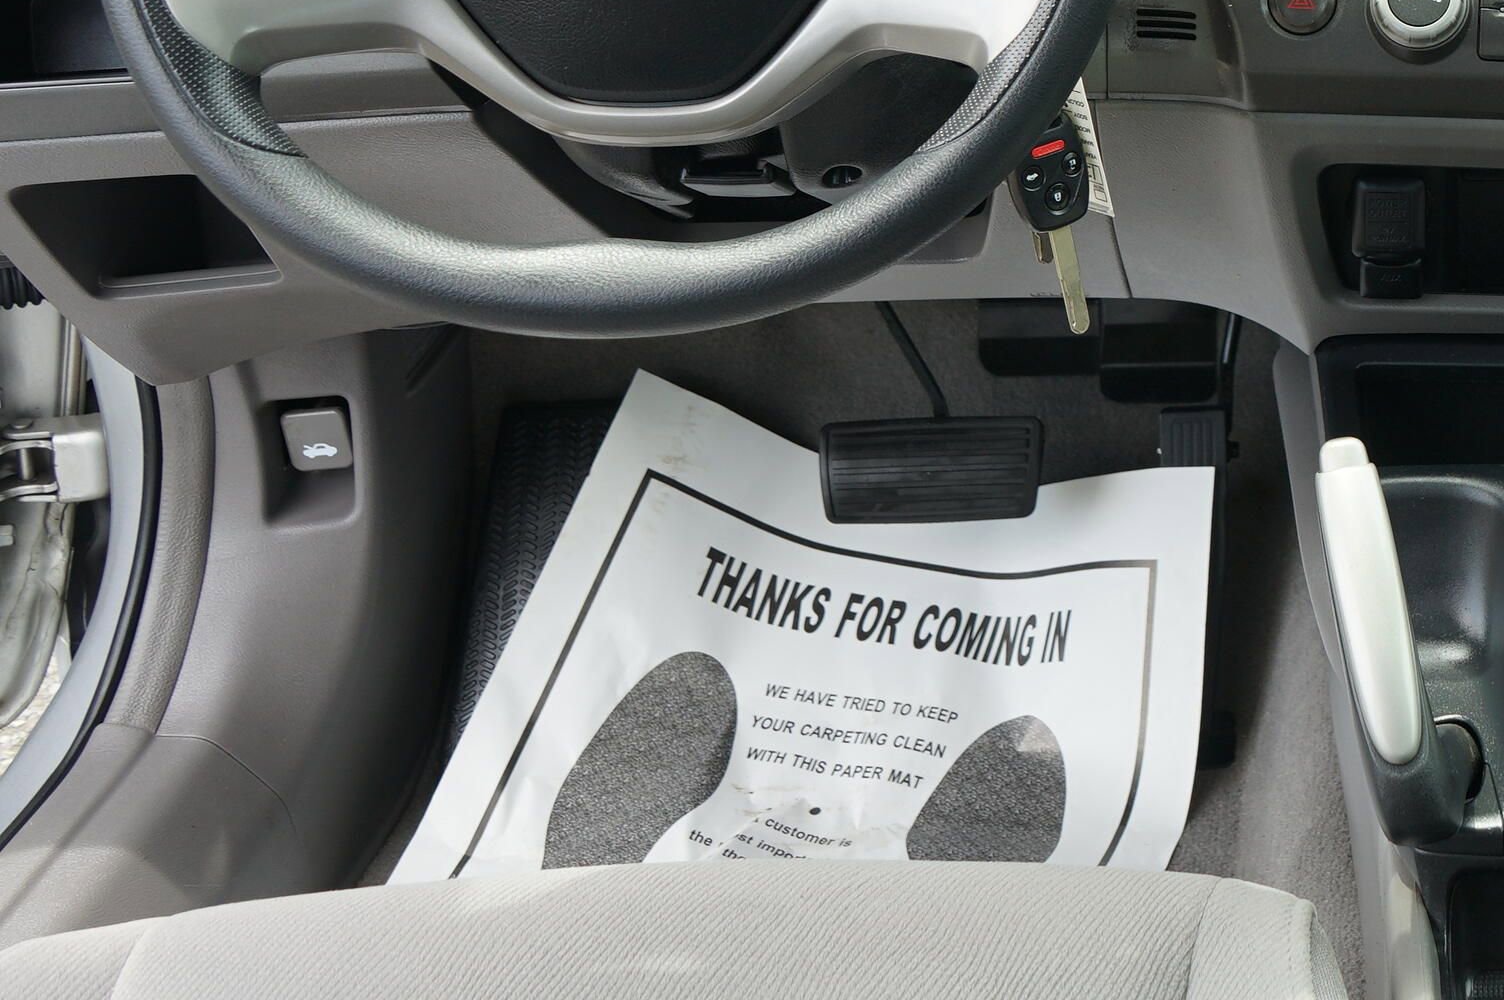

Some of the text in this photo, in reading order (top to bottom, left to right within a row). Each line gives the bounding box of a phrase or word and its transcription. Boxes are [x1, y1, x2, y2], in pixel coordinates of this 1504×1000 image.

[697, 546, 1072, 667] THANKS FOR COMING IN
[765, 683, 959, 724] WE HAVE TRIED TO KEEP
[751, 715, 948, 758] YOUR CARPETING CLEAN
[746, 747, 924, 790] WITH THIS PAPER MAT
[688, 829, 713, 847] the
[765, 817, 853, 848] customer is
